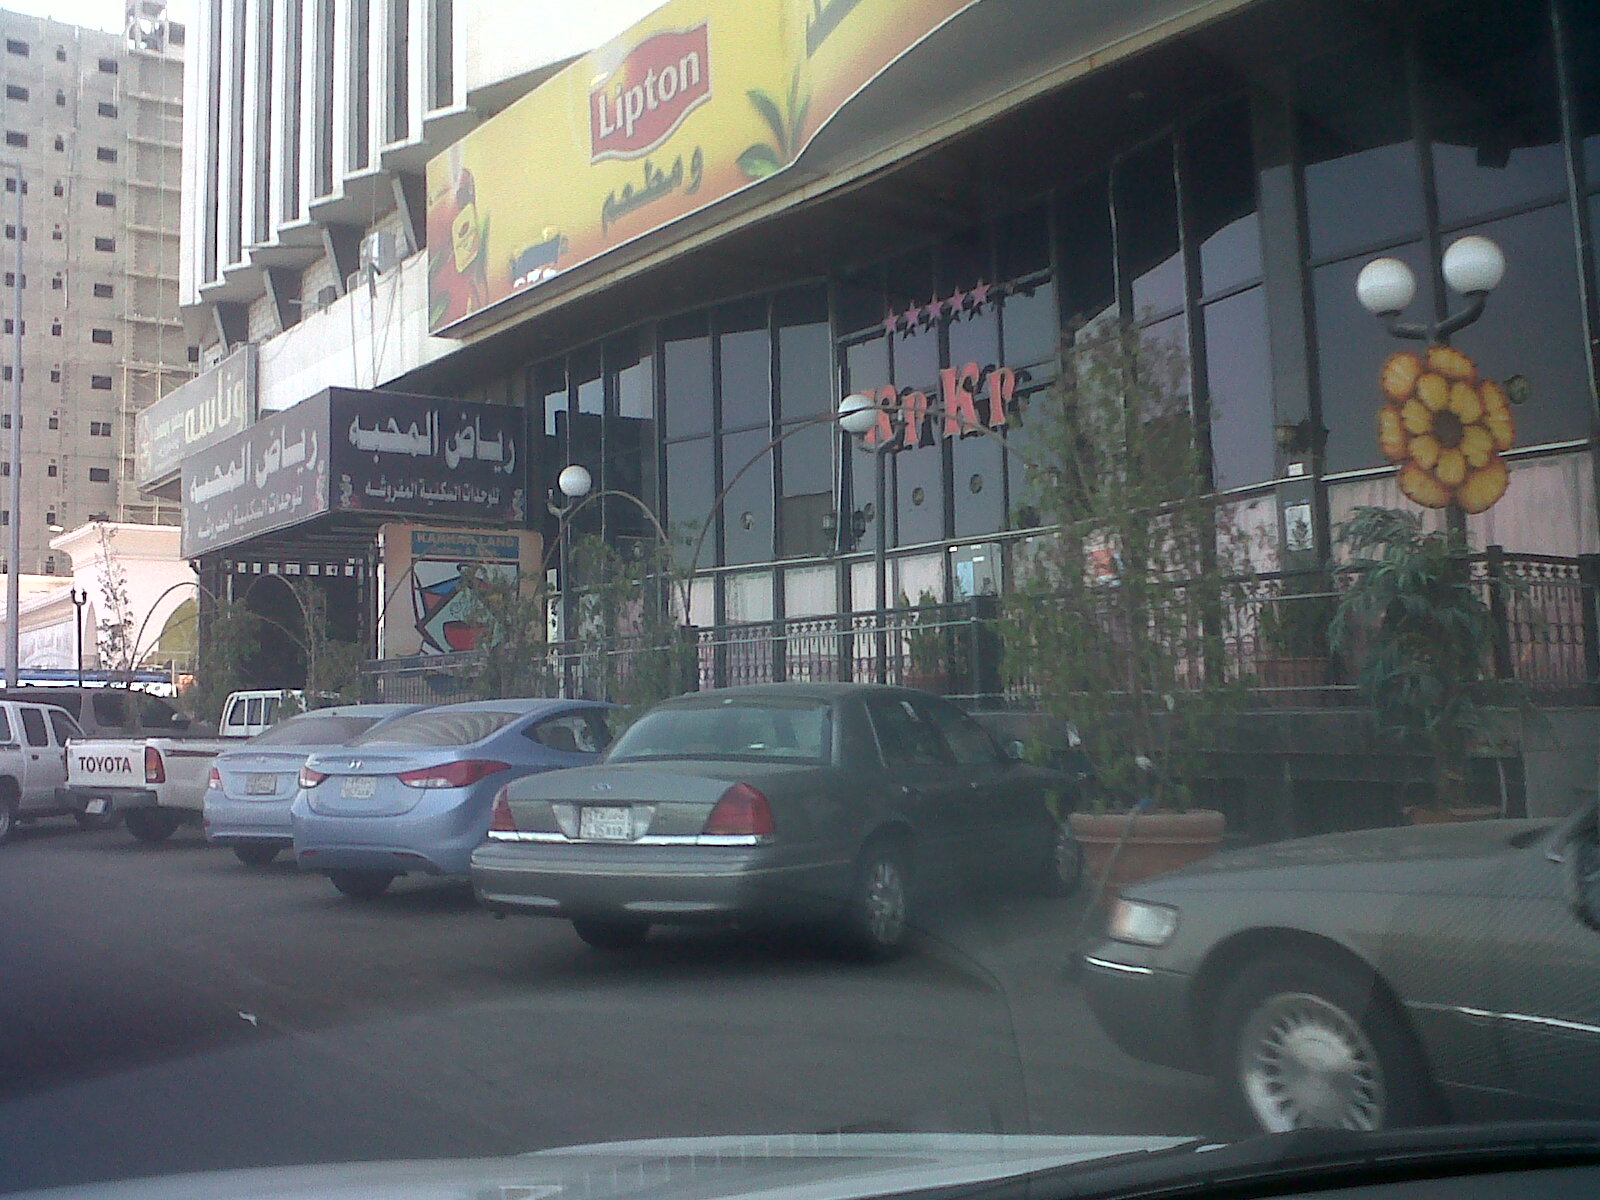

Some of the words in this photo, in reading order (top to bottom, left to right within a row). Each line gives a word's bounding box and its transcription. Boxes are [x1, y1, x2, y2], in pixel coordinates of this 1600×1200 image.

[597, 50, 701, 139] Lipton
[255, 424, 318, 490] رياض
[444, 411, 516, 475] رياض
[78, 755, 132, 774] TOYOTA
